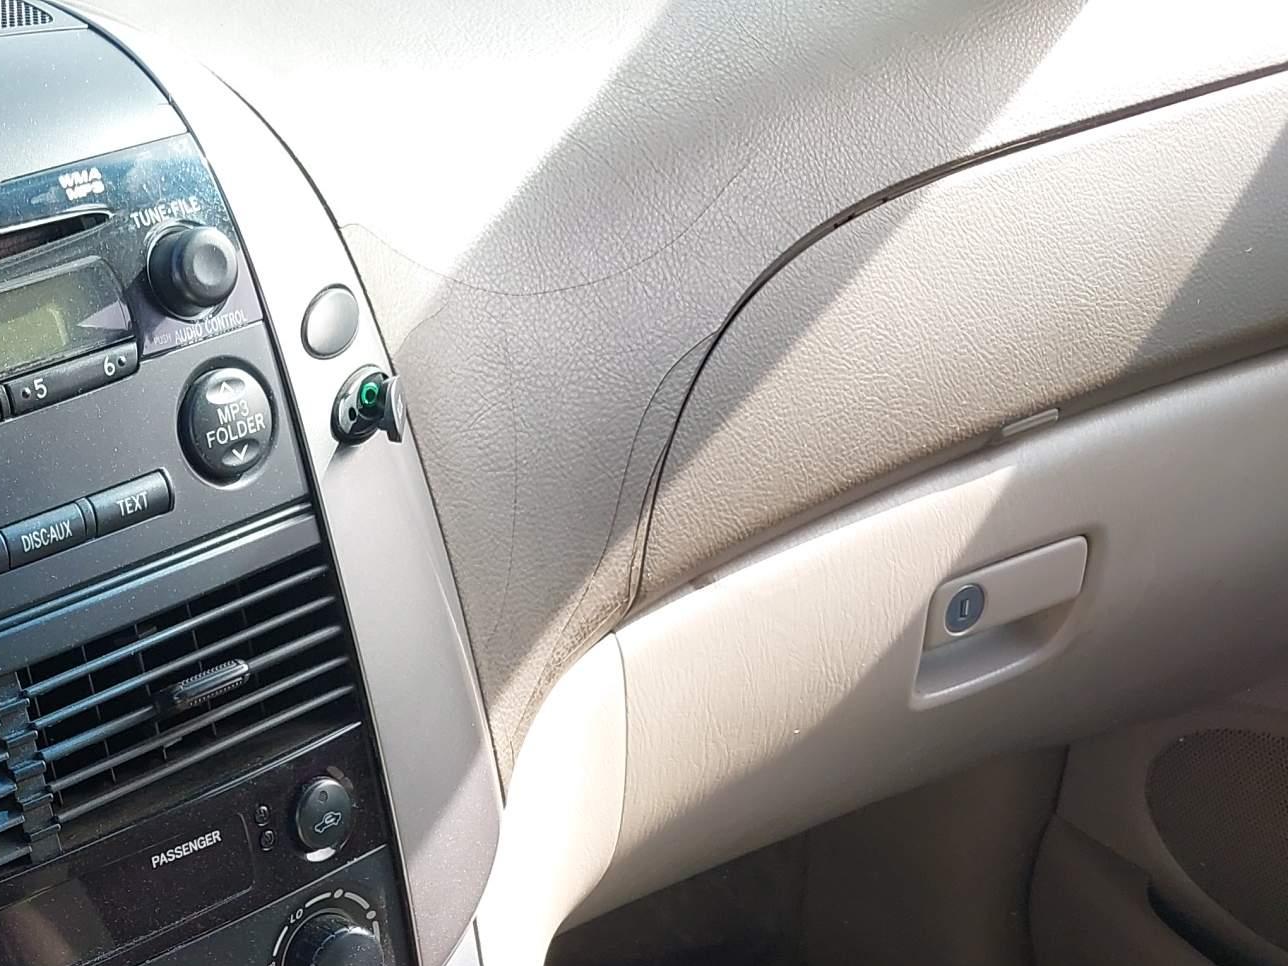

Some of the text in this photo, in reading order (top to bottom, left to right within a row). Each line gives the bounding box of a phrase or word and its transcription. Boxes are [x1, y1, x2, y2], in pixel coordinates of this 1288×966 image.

[175, 322, 203, 344] AUDIO
[204, 309, 247, 334] CONTROL
[103, 354, 116, 377] 6
[33, 377, 48, 399] 5
[216, 399, 249, 425] MP3
[206, 412, 266, 449] FOLDER
[116, 491, 148, 517] TEXT
[151, 829, 222, 869] PASSENGER
[289, 908, 304, 924] LO
